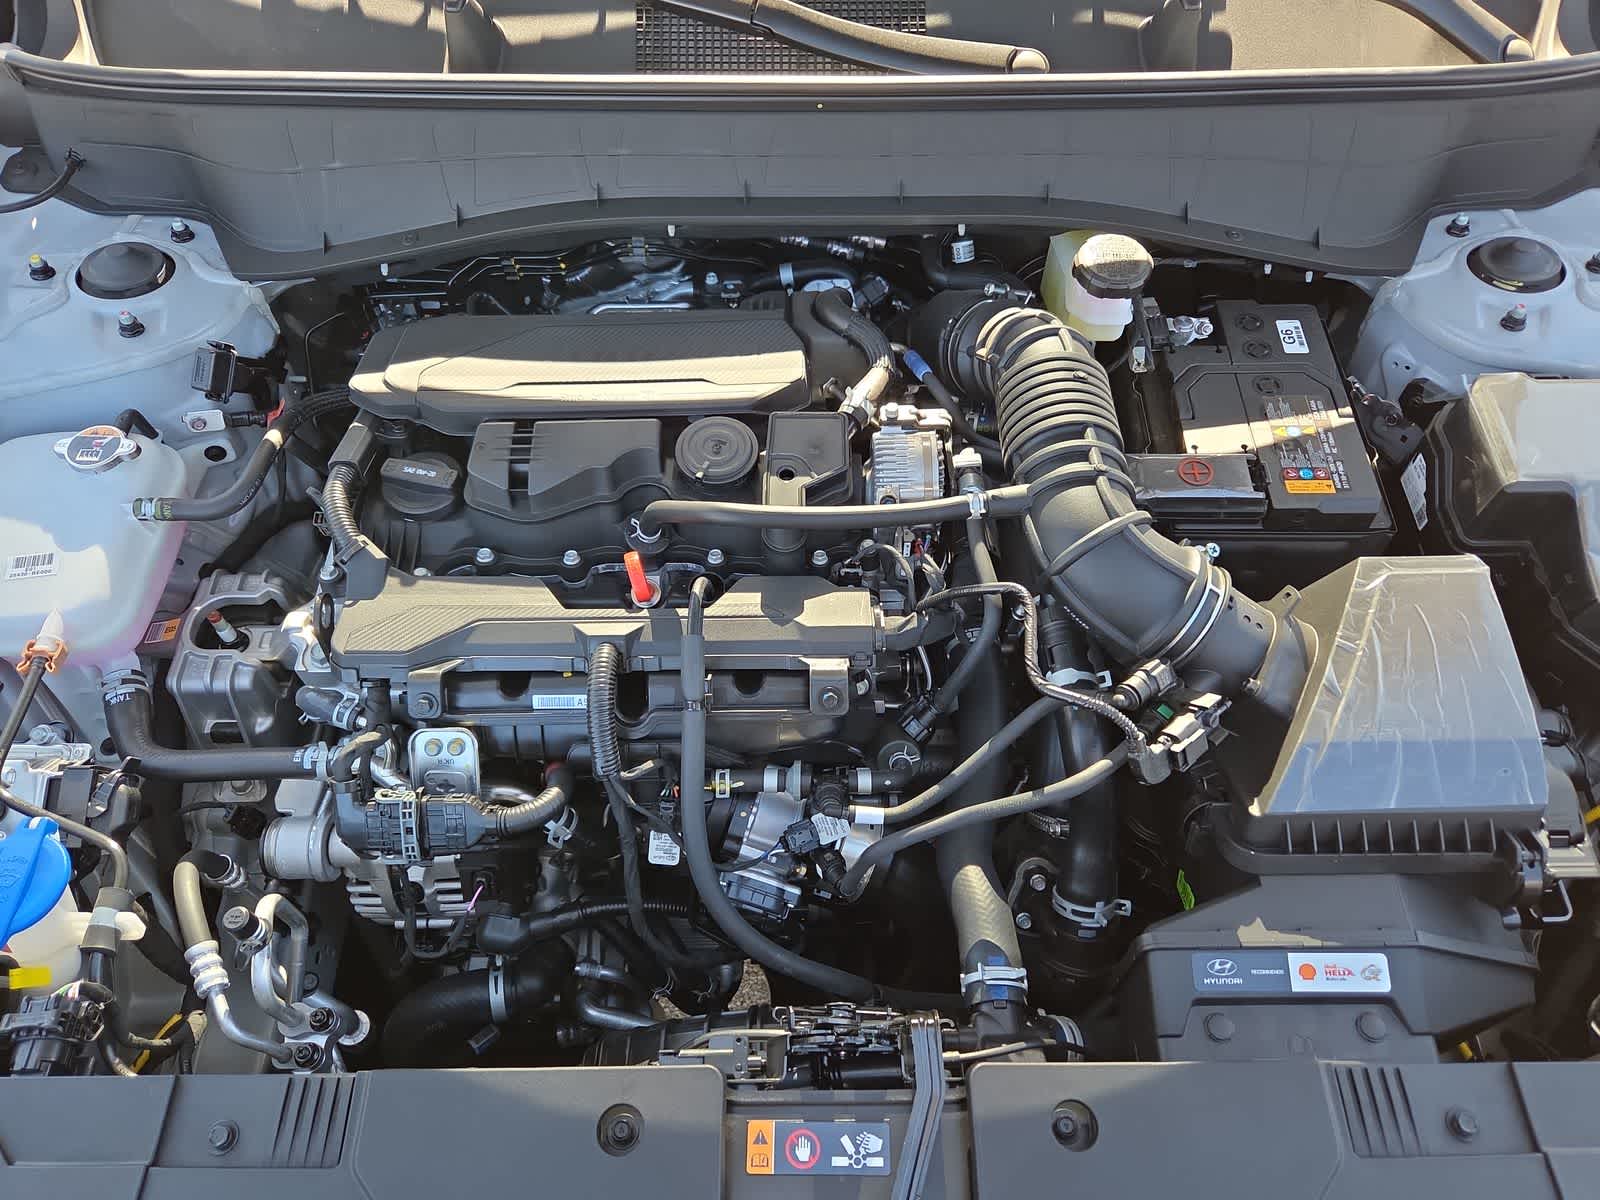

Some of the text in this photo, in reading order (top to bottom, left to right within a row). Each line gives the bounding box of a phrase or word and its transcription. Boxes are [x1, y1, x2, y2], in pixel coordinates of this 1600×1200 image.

[1281, 329, 1295, 344] G6
[109, 693, 131, 706] TANK
[1324, 967, 1353, 976] HELIX
[1203, 977, 1243, 985] HYUNDAI
